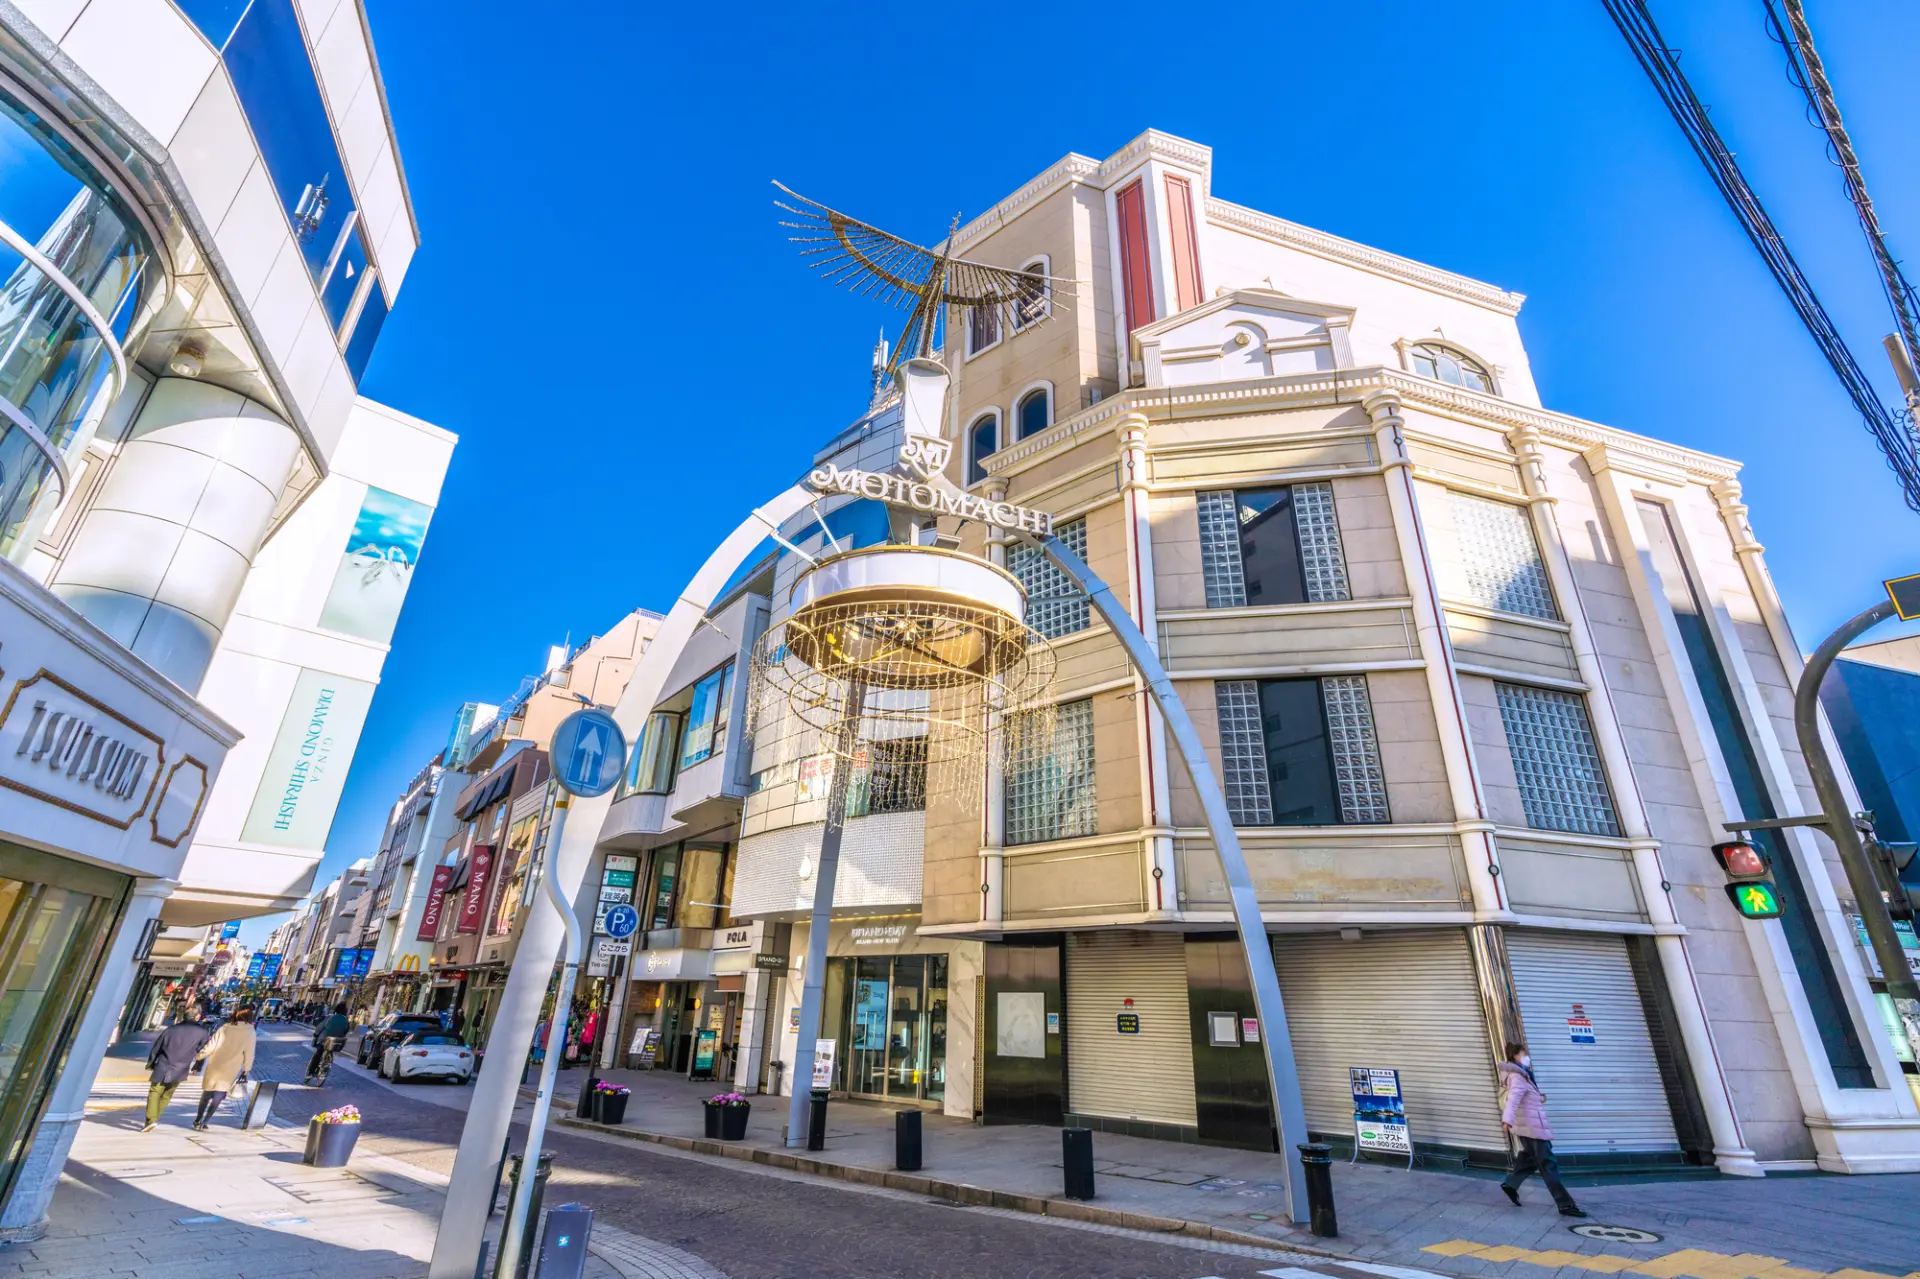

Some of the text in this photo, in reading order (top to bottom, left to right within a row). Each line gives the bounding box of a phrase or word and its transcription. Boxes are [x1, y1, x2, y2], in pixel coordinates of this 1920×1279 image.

[810, 463, 1053, 536] MOTOMACHI
[273, 688, 335, 831] DIAMOND SHIRAISHI
[309, 736, 332, 784] GINZA
[425, 887, 443, 925] MANO
[467, 871, 484, 915] MANO
[611, 912, 625, 931] P
[726, 931, 747, 943] POLA
[600, 944, 628, 952] ここから
[1383, 1133, 1403, 1141] マスト
